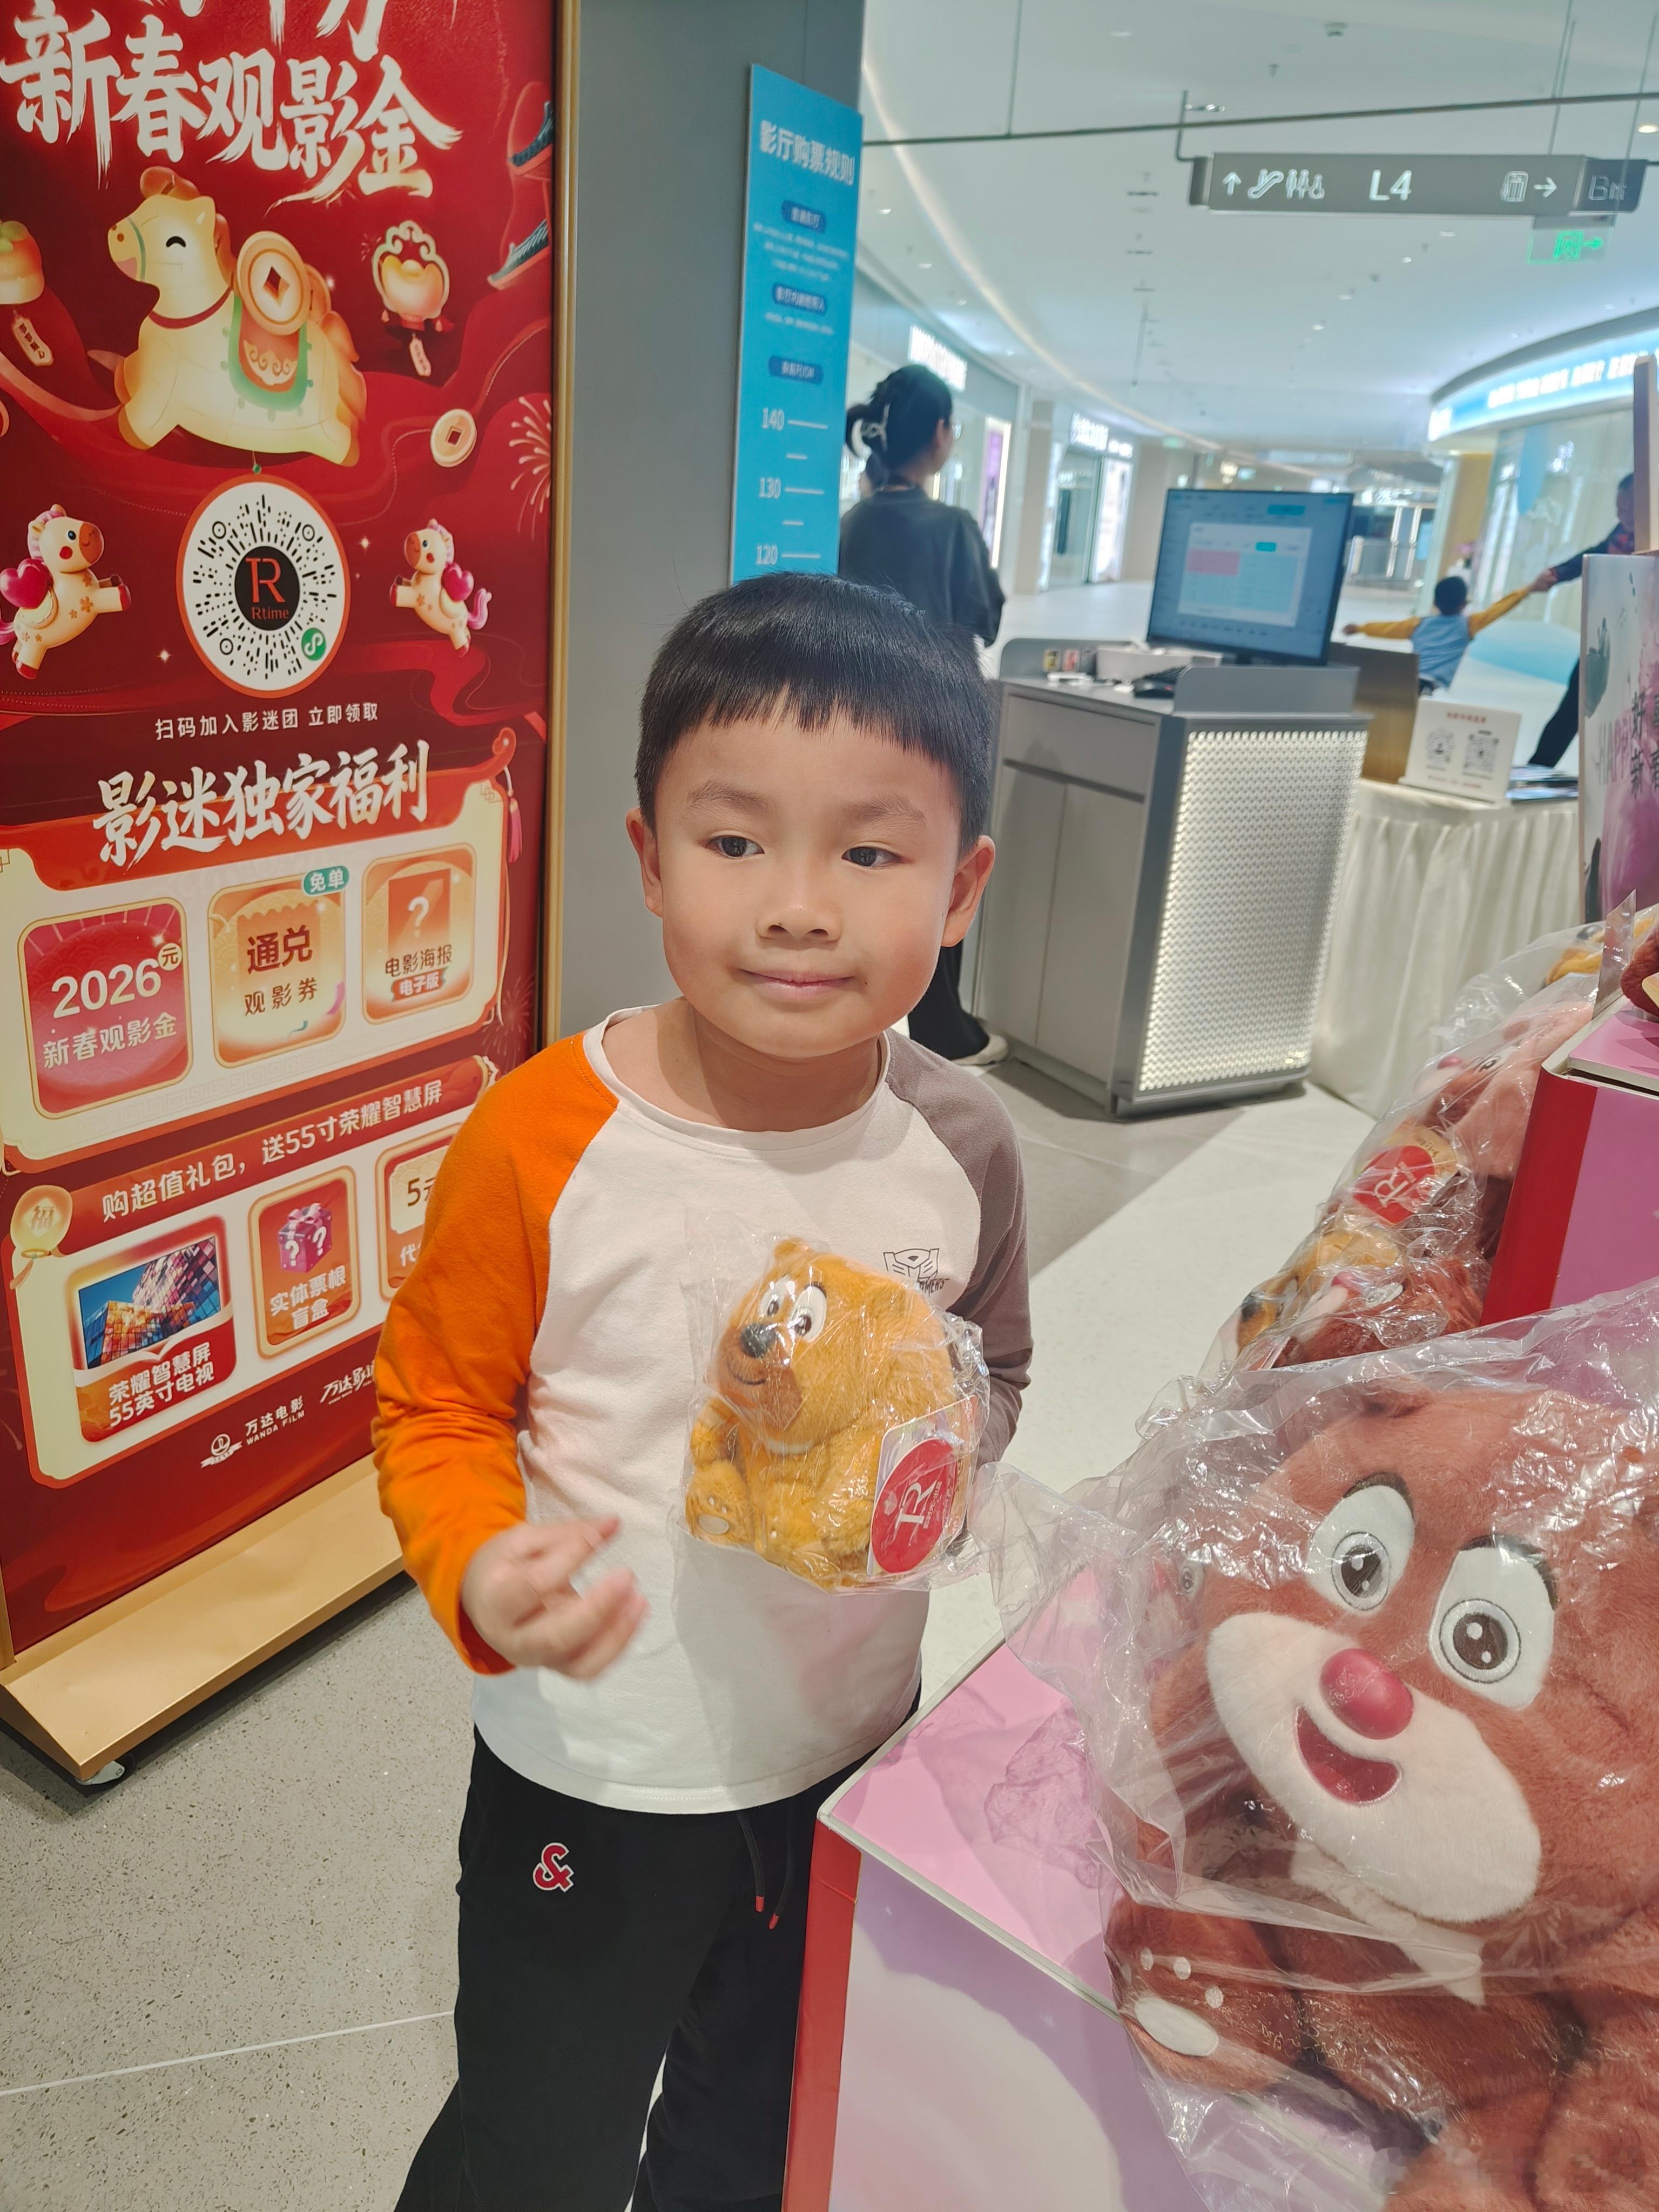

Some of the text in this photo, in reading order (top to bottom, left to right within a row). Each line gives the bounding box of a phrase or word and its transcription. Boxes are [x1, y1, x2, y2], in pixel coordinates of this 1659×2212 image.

[0, 0, 463, 215] 新春观影金
[760, 120, 855, 185] 影厅购票规则
[1369, 170, 1412, 200] L4
[762, 407, 785, 430] 140
[759, 477, 781, 499] 130
[756, 544, 778, 565] 120
[251, 606, 289, 619] Rtime
[156, 703, 378, 740] 扫码加入影迷团 立即领取
[93, 739, 431, 871] 影迷独家福利
[311, 868, 344, 893] 免单
[162, 948, 179, 965] 元
[247, 925, 313, 974] 通兑
[386, 944, 452, 977] 电影海报
[51, 958, 161, 1019] 2026
[244, 978, 318, 1017] 观影券
[400, 971, 440, 996] 电子版
[43, 1012, 177, 1069] 新春观影金
[400, 1242, 421, 1267] 代
[271, 1265, 346, 1316] 实体票根
[292, 1298, 329, 1330] 盲盒
[109, 1342, 211, 1405] 荣耀智慧屏
[110, 1362, 214, 1427] 55英寸电视
[245, 1395, 304, 1437] 万达电影
[246, 1410, 305, 1445] WANDA FILM
[532, 1842, 575, 1893] &
